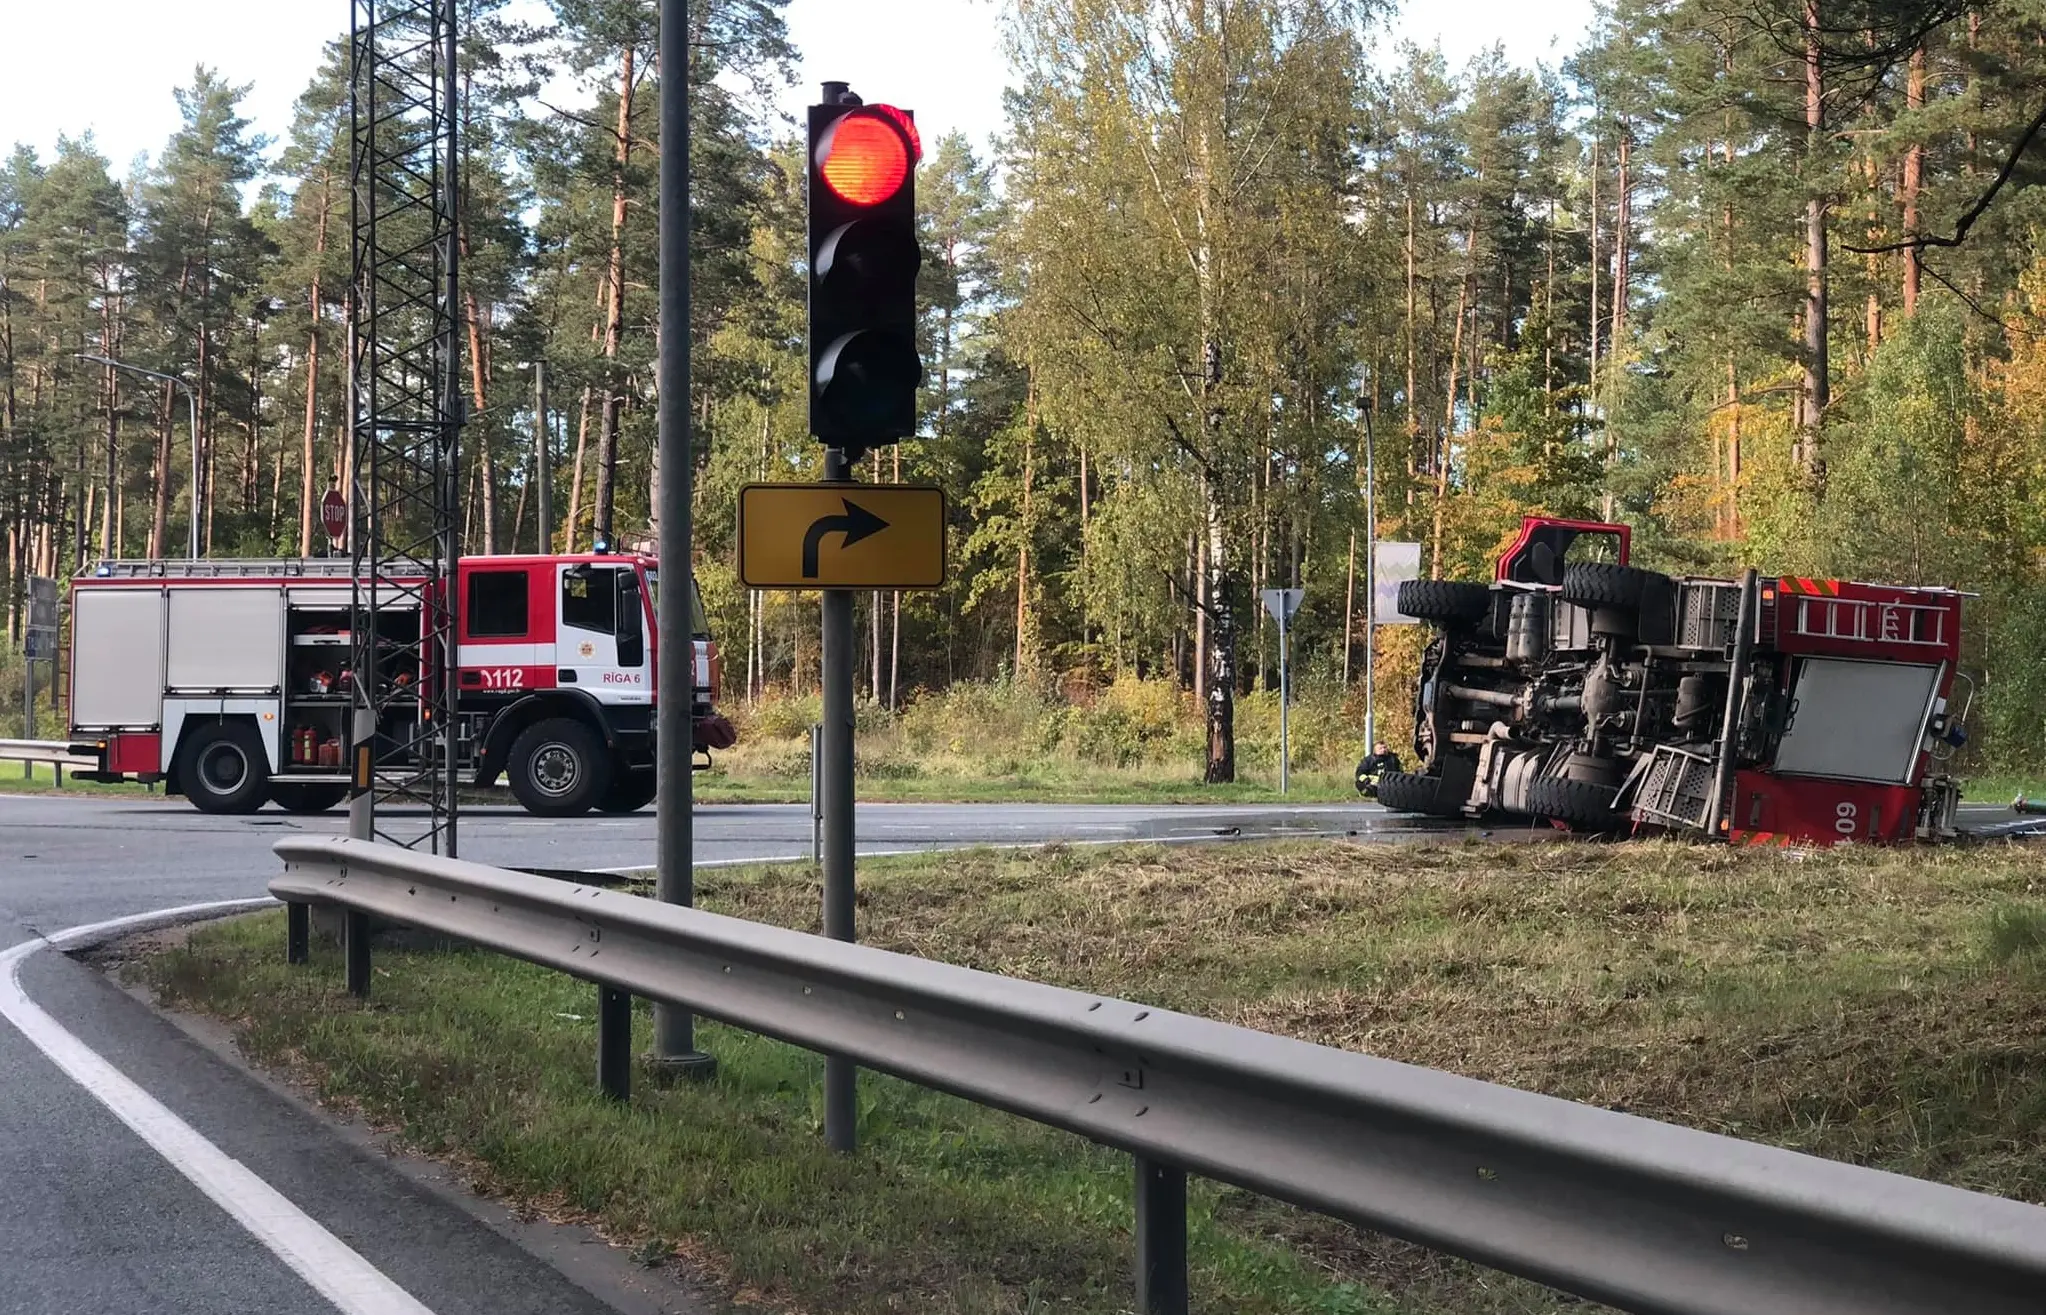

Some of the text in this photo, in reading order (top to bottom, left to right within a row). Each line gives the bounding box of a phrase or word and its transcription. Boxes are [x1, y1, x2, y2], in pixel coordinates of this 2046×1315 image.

[325, 503, 345, 523] STOP
[492, 669, 523, 687] 112
[634, 674, 641, 683] 6
